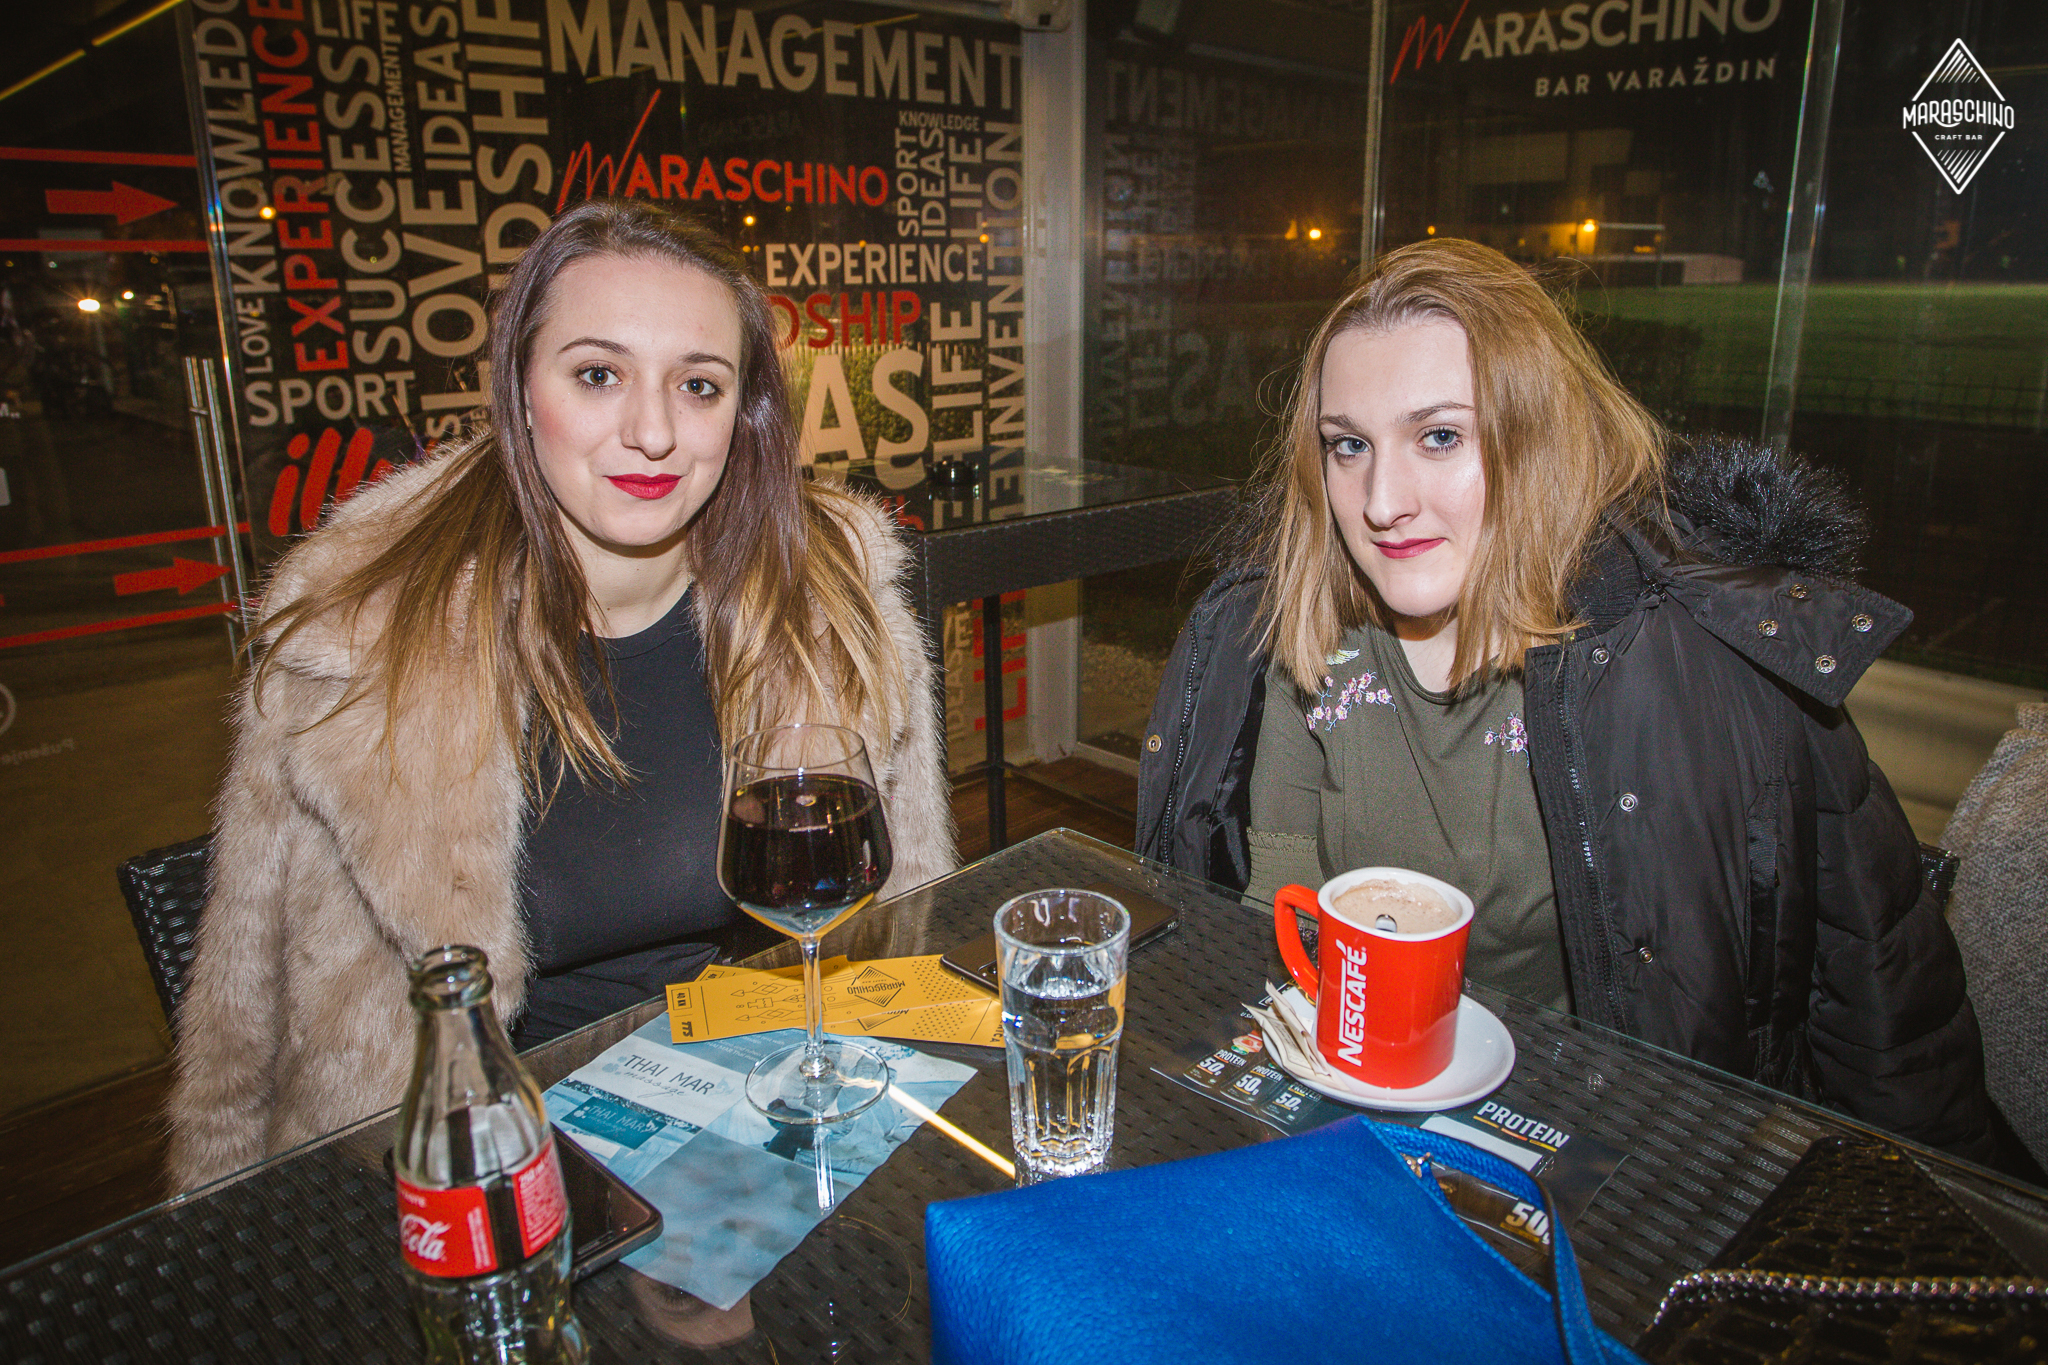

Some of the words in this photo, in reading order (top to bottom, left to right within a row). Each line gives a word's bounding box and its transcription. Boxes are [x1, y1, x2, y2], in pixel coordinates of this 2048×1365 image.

[311, 0, 403, 45] LIFE
[546, 0, 1022, 110] MANAGEMENT
[381, 41, 413, 173] MANAGEMENT
[409, 4, 474, 171] IDEAS
[1535, 73, 1591, 98] BAR
[1607, 57, 1779, 92] VARAŽDIN
[197, 0, 281, 294] KNOWLED
[899, 111, 980, 132] KNOWLEDGE
[317, 44, 413, 365] SUCCESS
[894, 127, 919, 237] SPORT
[919, 127, 947, 237] IDEAS
[948, 135, 983, 238] LIFE
[396, 178, 492, 411] LOVE
[765, 243, 984, 286] EXPERIENCE
[984, 121, 1025, 448] INVENTION
[236, 297, 274, 374] LOVE
[245, 370, 416, 427] SPORT
[930, 301, 984, 450] LIFE
[847, 980, 906, 996] MARASCHINO
[1336, 938, 1368, 1067] NESCAFÉ
[623, 1054, 669, 1078] THAI
[668, 1071, 715, 1096] MAR
[623, 1072, 686, 1099] massage
[1215, 1049, 1247, 1067] PROTEIN
[1252, 1065, 1285, 1082] PROTEIN
[588, 1105, 617, 1120] THAI
[1477, 1101, 1570, 1148] PROTEIN
